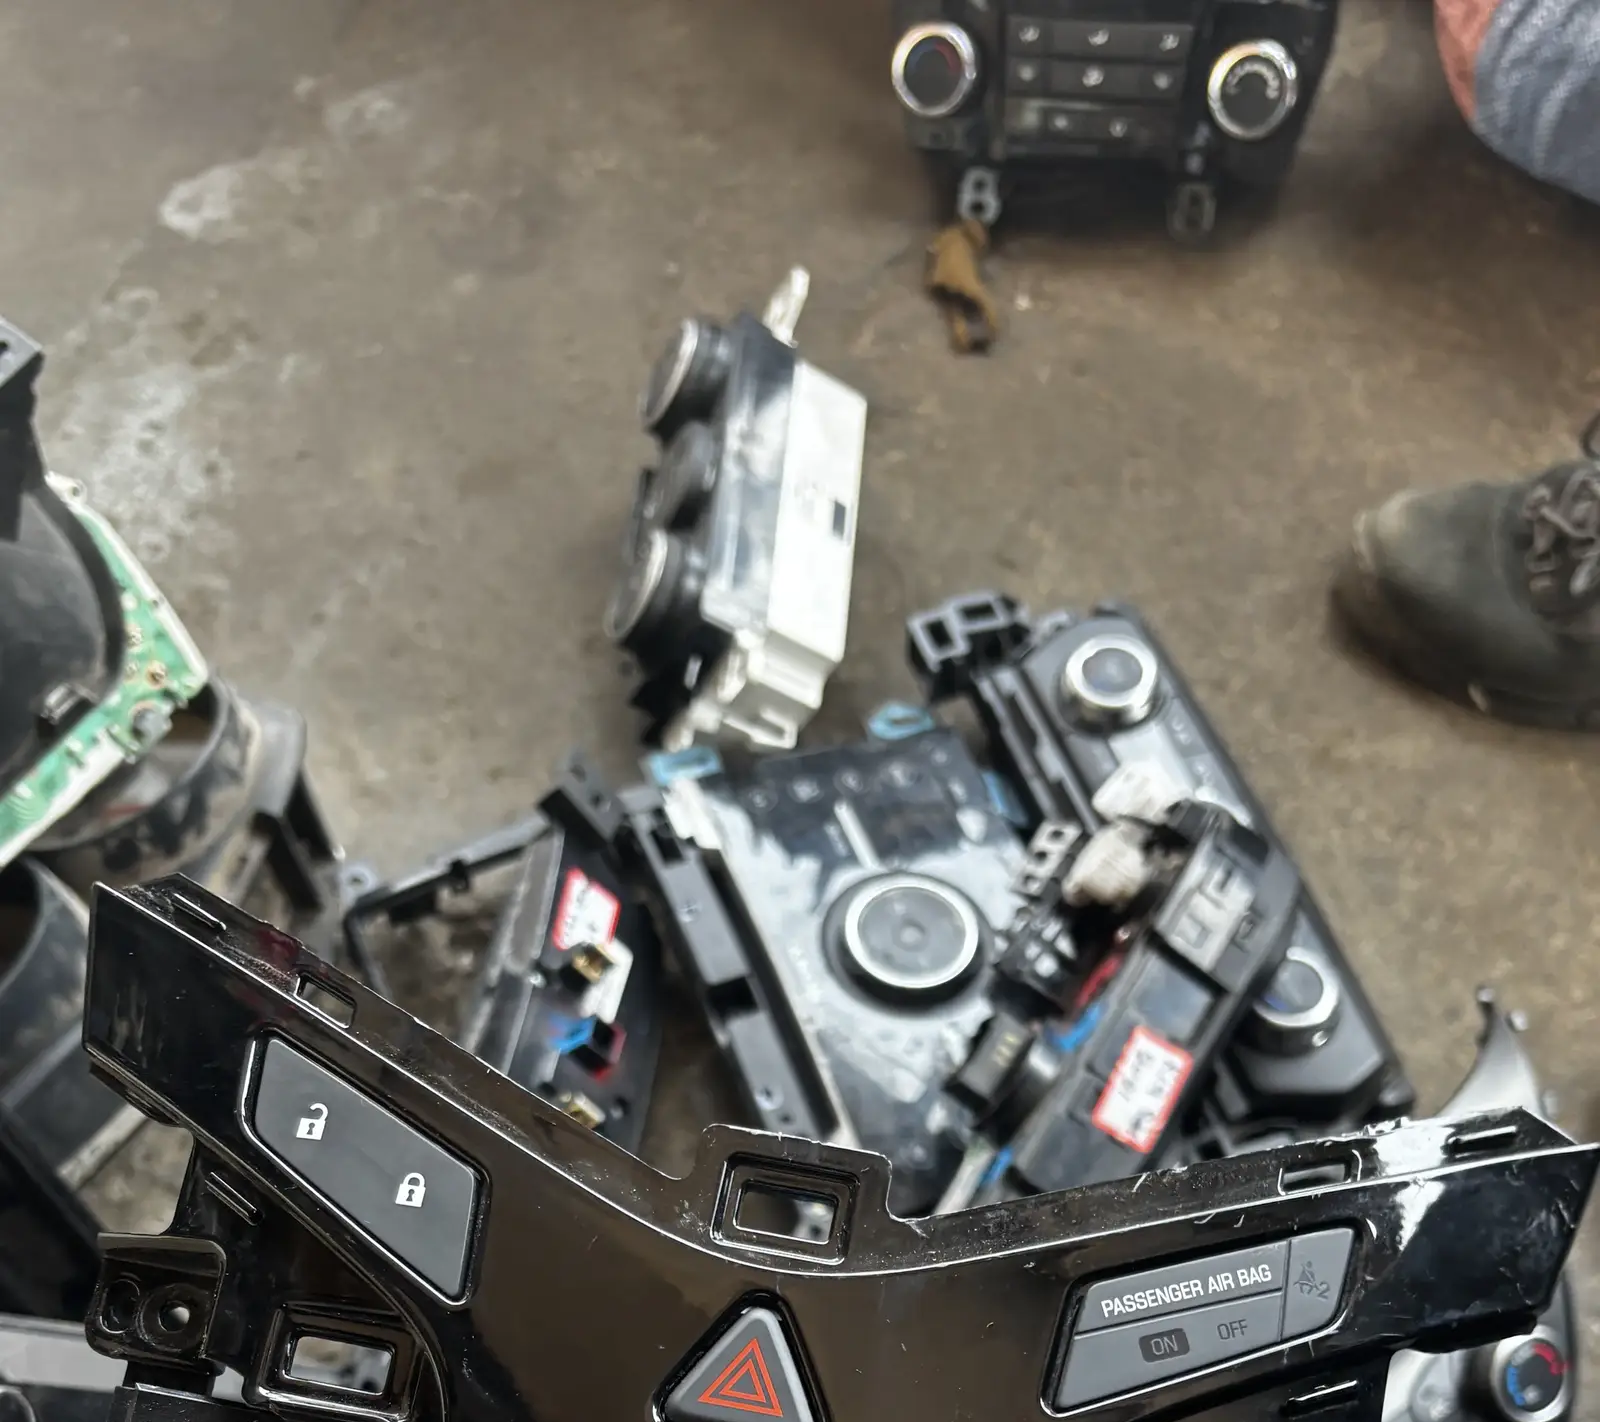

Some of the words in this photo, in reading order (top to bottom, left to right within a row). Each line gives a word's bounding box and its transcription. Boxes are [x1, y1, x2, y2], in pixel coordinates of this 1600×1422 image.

[1101, 1279, 1204, 1318] PASSENGER
[1208, 1272, 1235, 1294] AIR
[1237, 1263, 1272, 1287] BAG
[1150, 1334, 1179, 1356] ON
[1217, 1319, 1248, 1341] OFF
